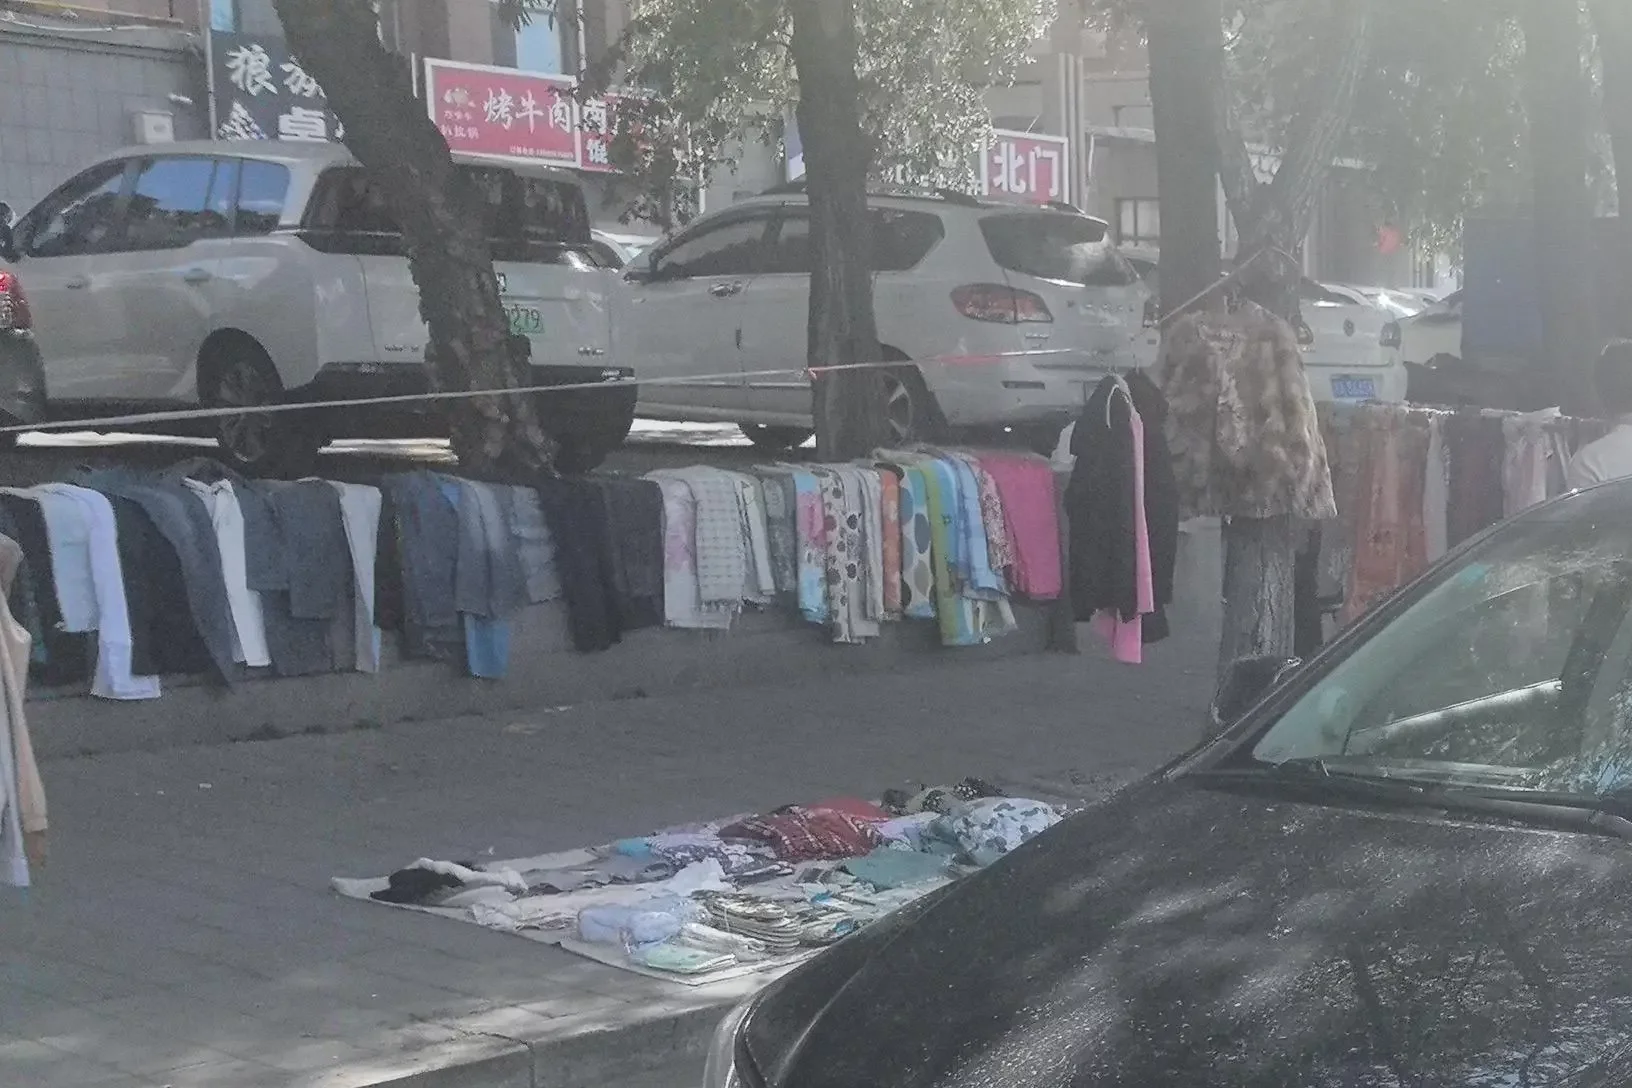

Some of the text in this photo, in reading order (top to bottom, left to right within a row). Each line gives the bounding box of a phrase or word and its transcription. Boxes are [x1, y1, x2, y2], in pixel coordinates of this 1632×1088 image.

[483, 87, 573, 134] 烤牛肉
[992, 141, 1059, 197] 北门
